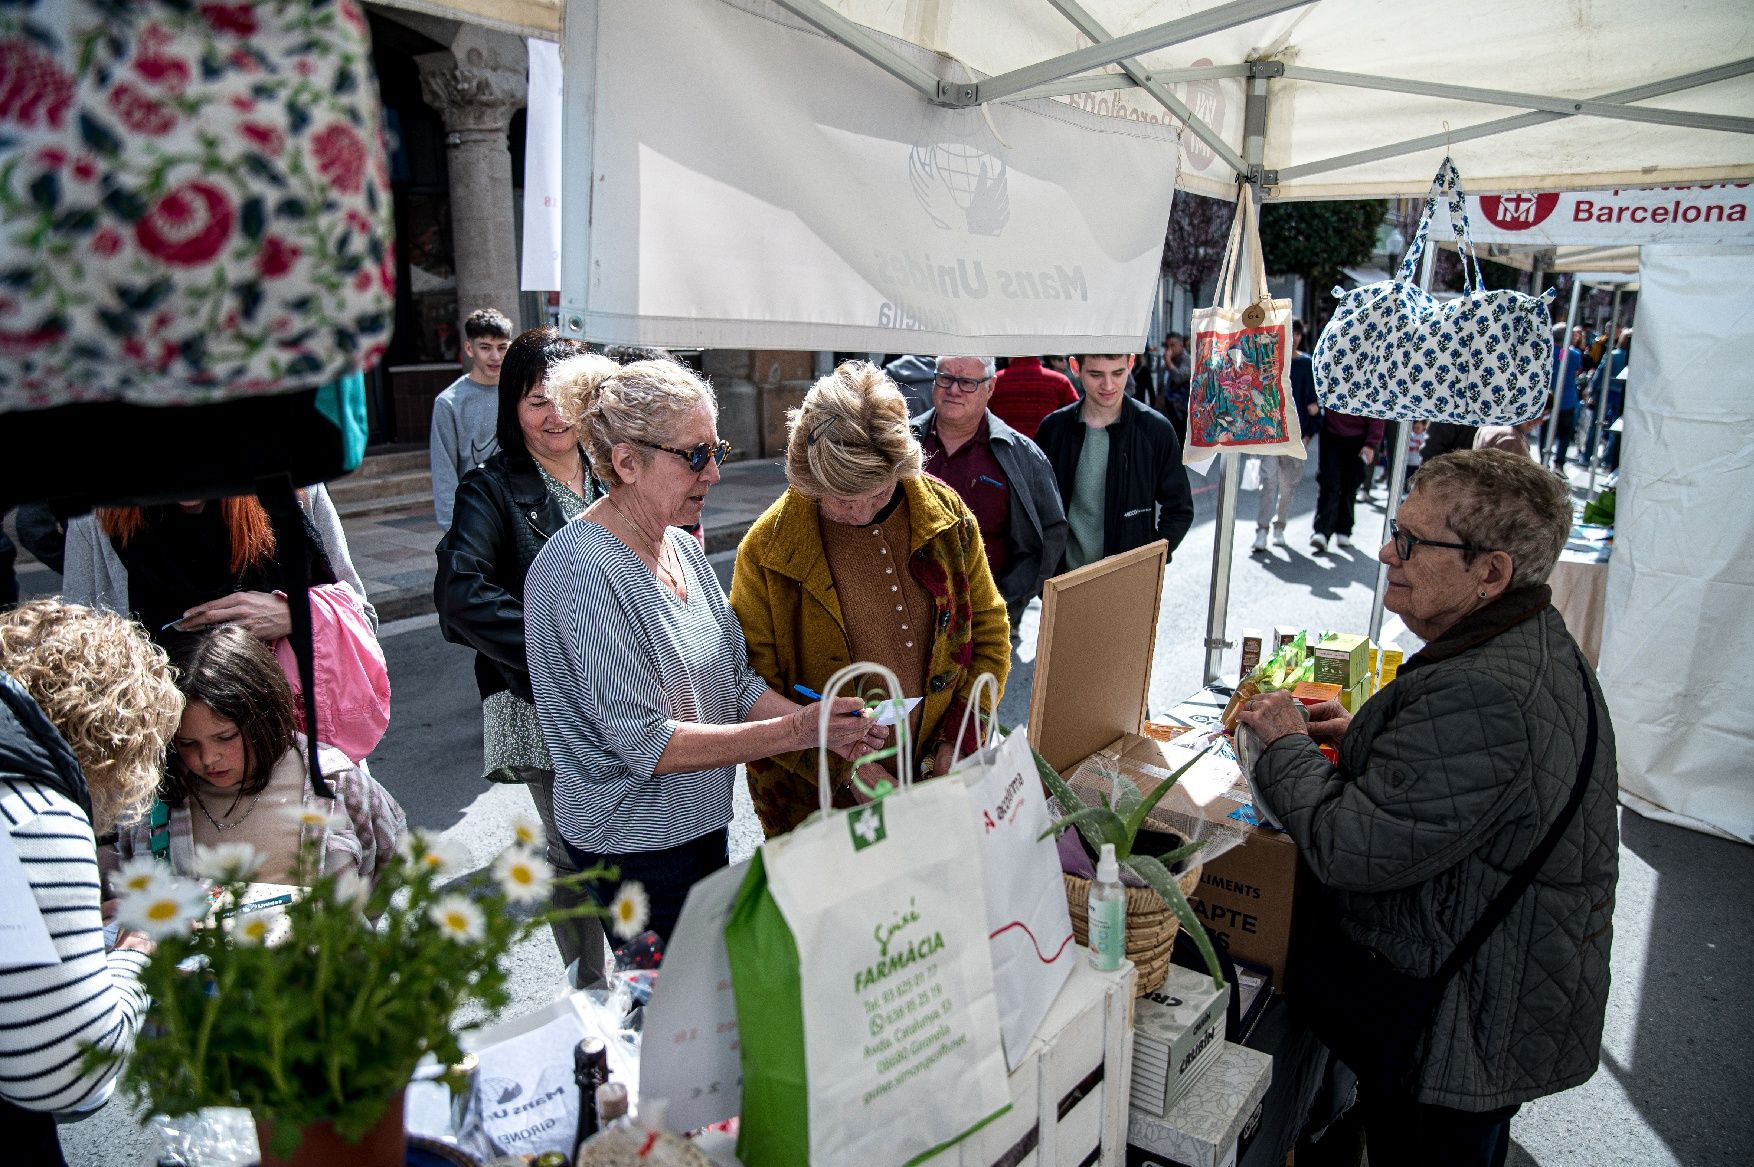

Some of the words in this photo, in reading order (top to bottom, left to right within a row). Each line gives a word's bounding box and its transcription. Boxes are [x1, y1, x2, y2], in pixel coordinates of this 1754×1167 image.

[1573, 199, 1748, 224] Barcelona
[1201, 872, 1261, 899] LIMENTS
[1193, 899, 1258, 934] APTE
[854, 931, 945, 994] FARMÀCIA
